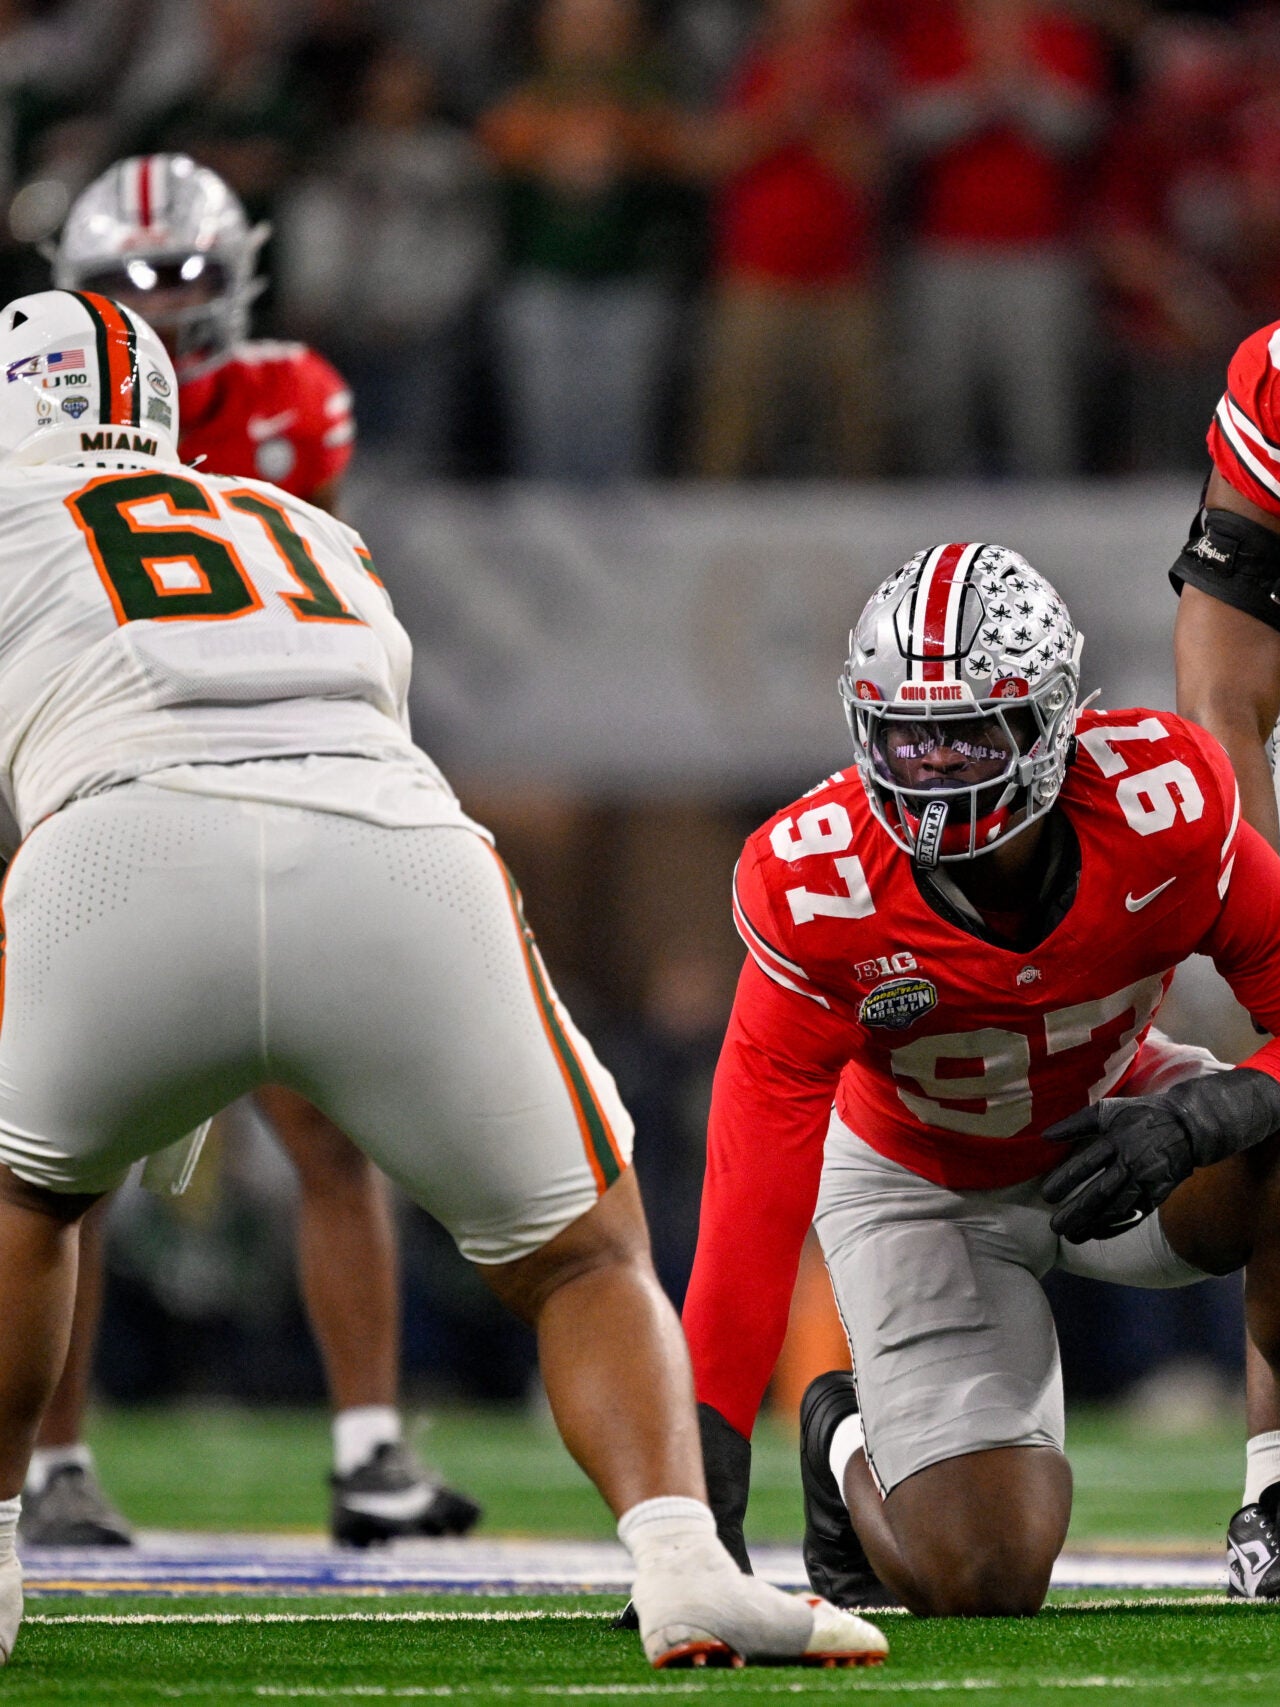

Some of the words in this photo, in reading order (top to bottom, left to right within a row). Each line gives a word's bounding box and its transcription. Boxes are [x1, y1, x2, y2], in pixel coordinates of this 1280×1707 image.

[64, 374, 87, 386] 100
[80, 432, 158, 457] MIAMI
[63, 469, 369, 627] 61
[901, 686, 926, 701] OHIO
[930, 685, 962, 700] STATE
[896, 744, 917, 759] PHIL
[1076, 717, 1205, 837] 97
[919, 804, 944, 864] BATTLE
[769, 802, 877, 926] 97
[866, 989, 930, 1019] COTTON
[878, 1002, 918, 1018] BOWL
[891, 973, 1164, 1138] 97
